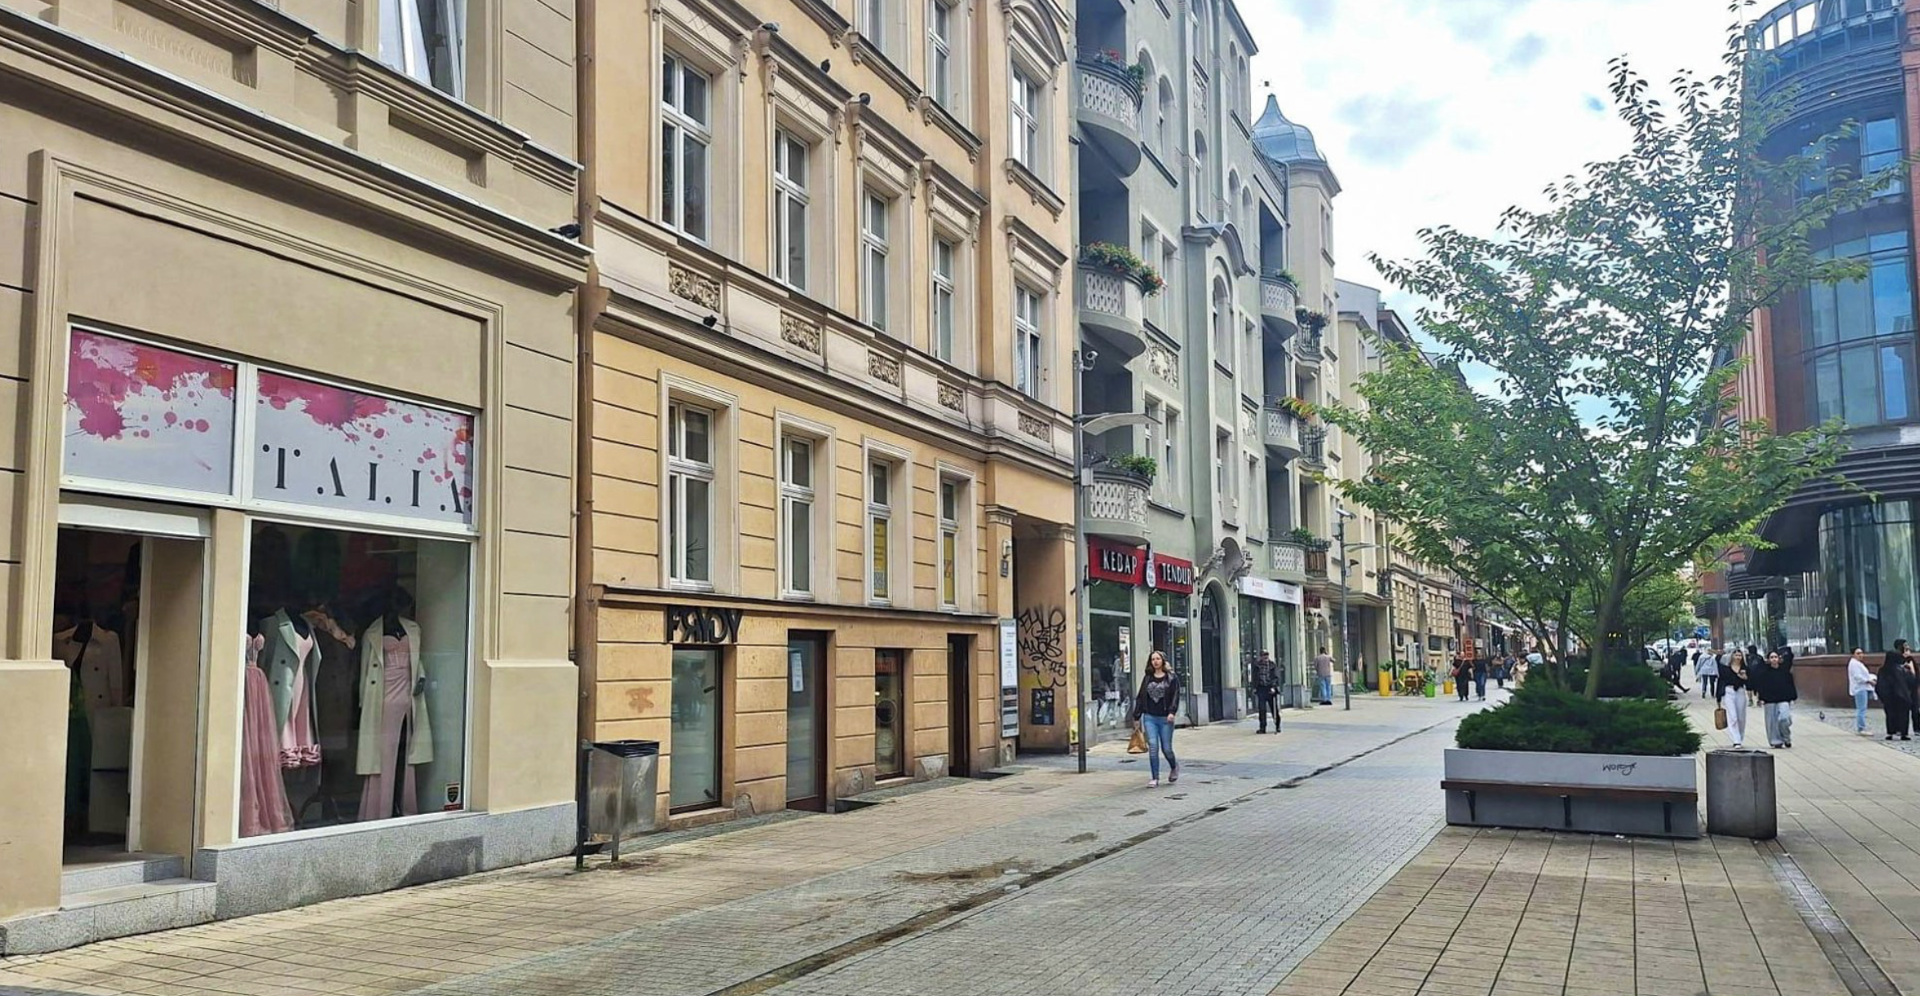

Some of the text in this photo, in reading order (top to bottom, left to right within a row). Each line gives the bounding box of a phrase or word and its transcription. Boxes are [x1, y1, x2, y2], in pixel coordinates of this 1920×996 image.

[262, 443, 465, 514] TALIA
[1102, 549, 1138, 575] KEBAP
[1161, 562, 1193, 586] TENDUR
